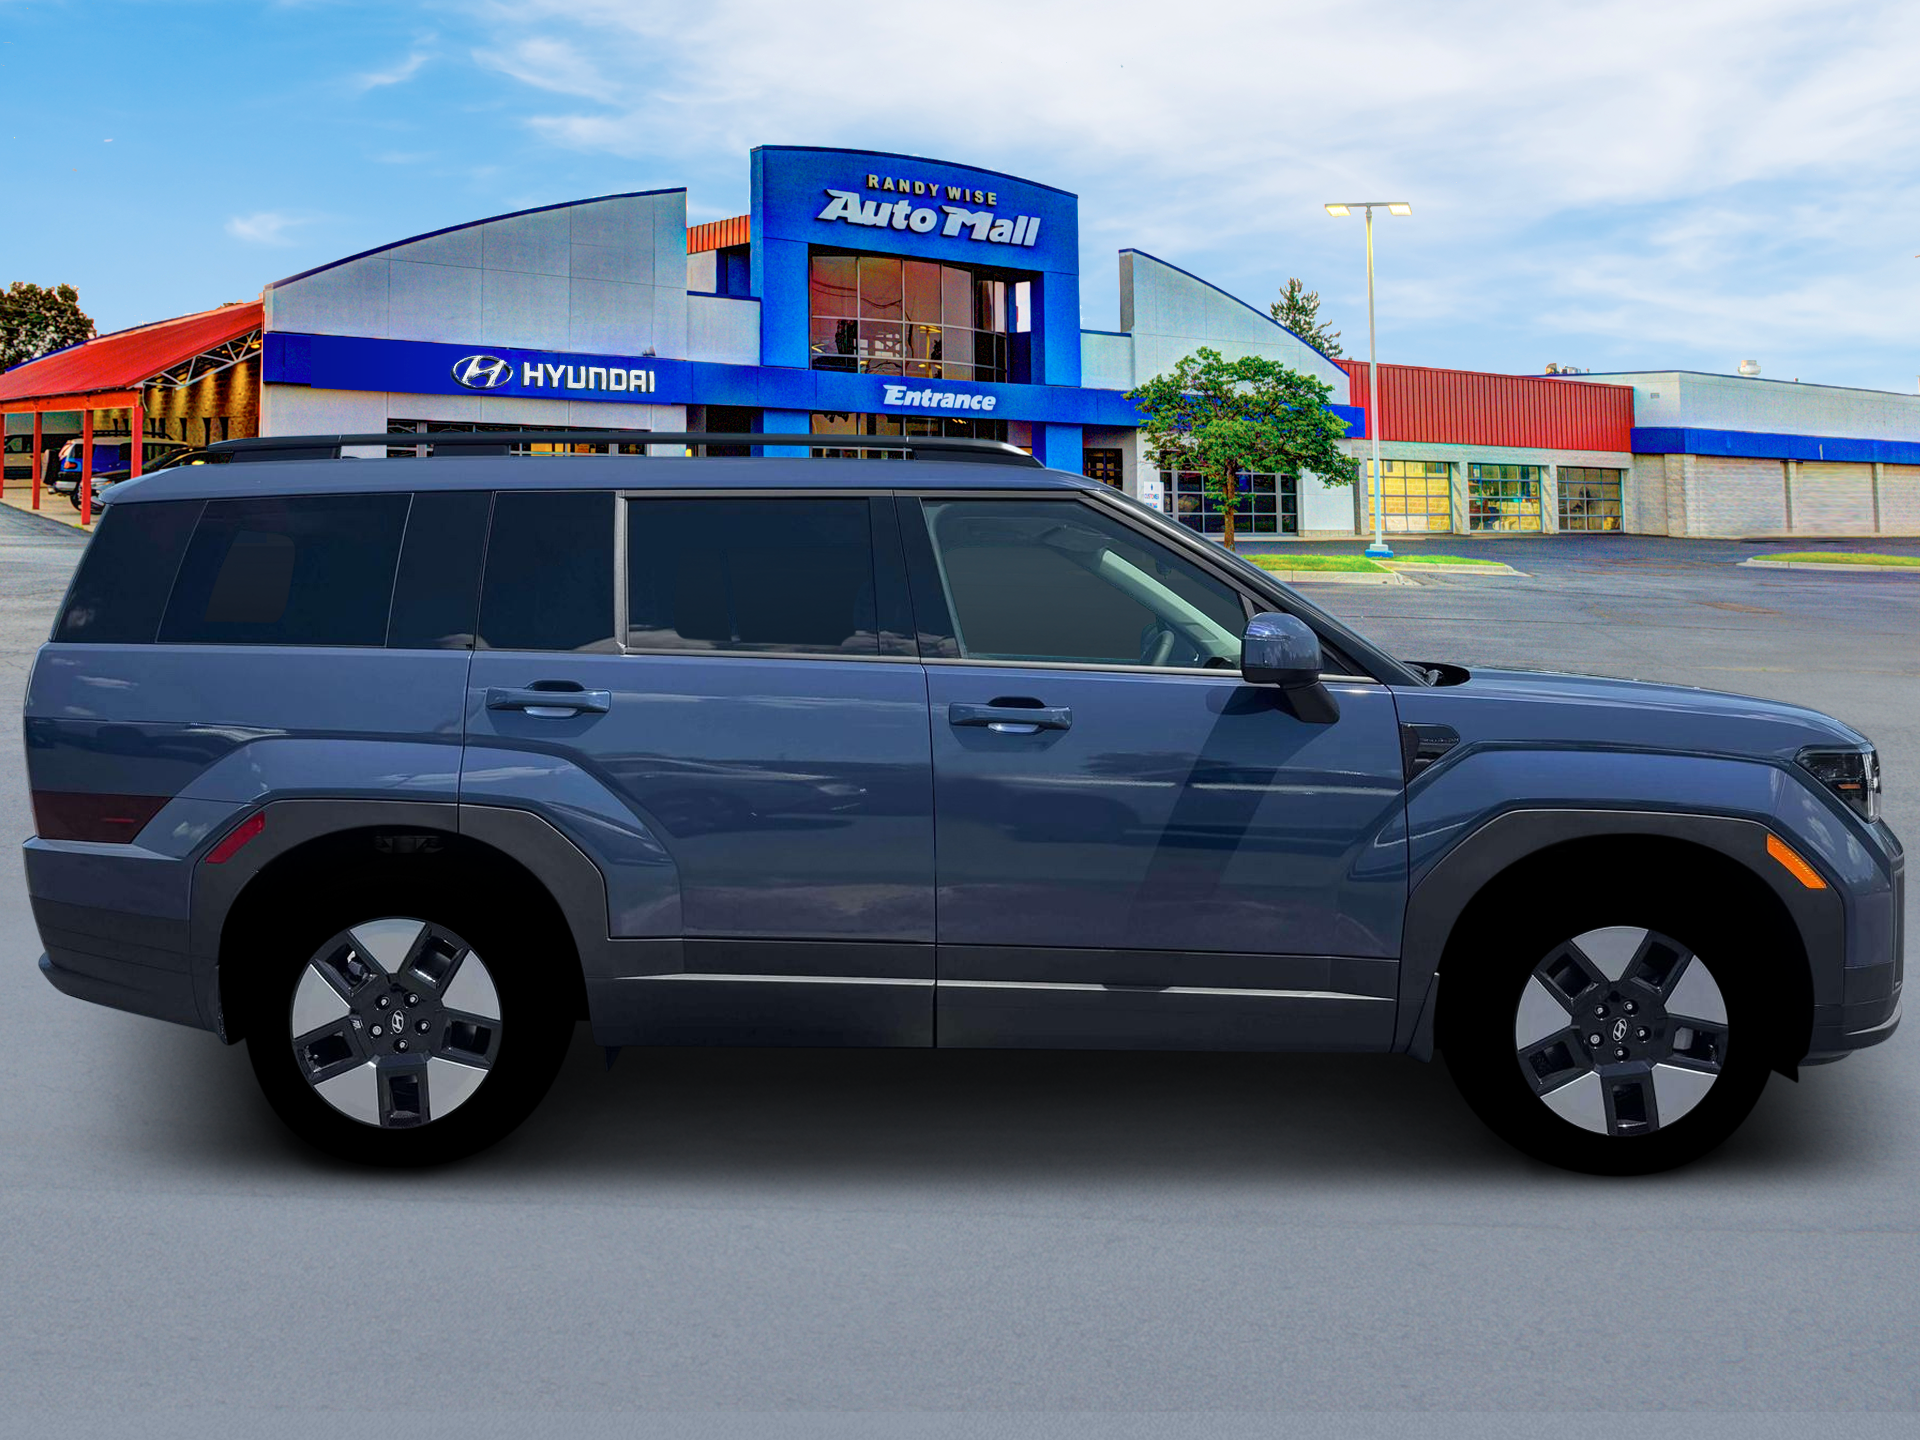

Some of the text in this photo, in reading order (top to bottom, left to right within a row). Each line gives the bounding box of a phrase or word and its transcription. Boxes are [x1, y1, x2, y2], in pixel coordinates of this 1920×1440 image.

[867, 173, 997, 206] RANDY WISE
[817, 188, 1041, 247] Auto Mall
[522, 362, 655, 393] HYUNDAI
[882, 384, 997, 411] Entrance
